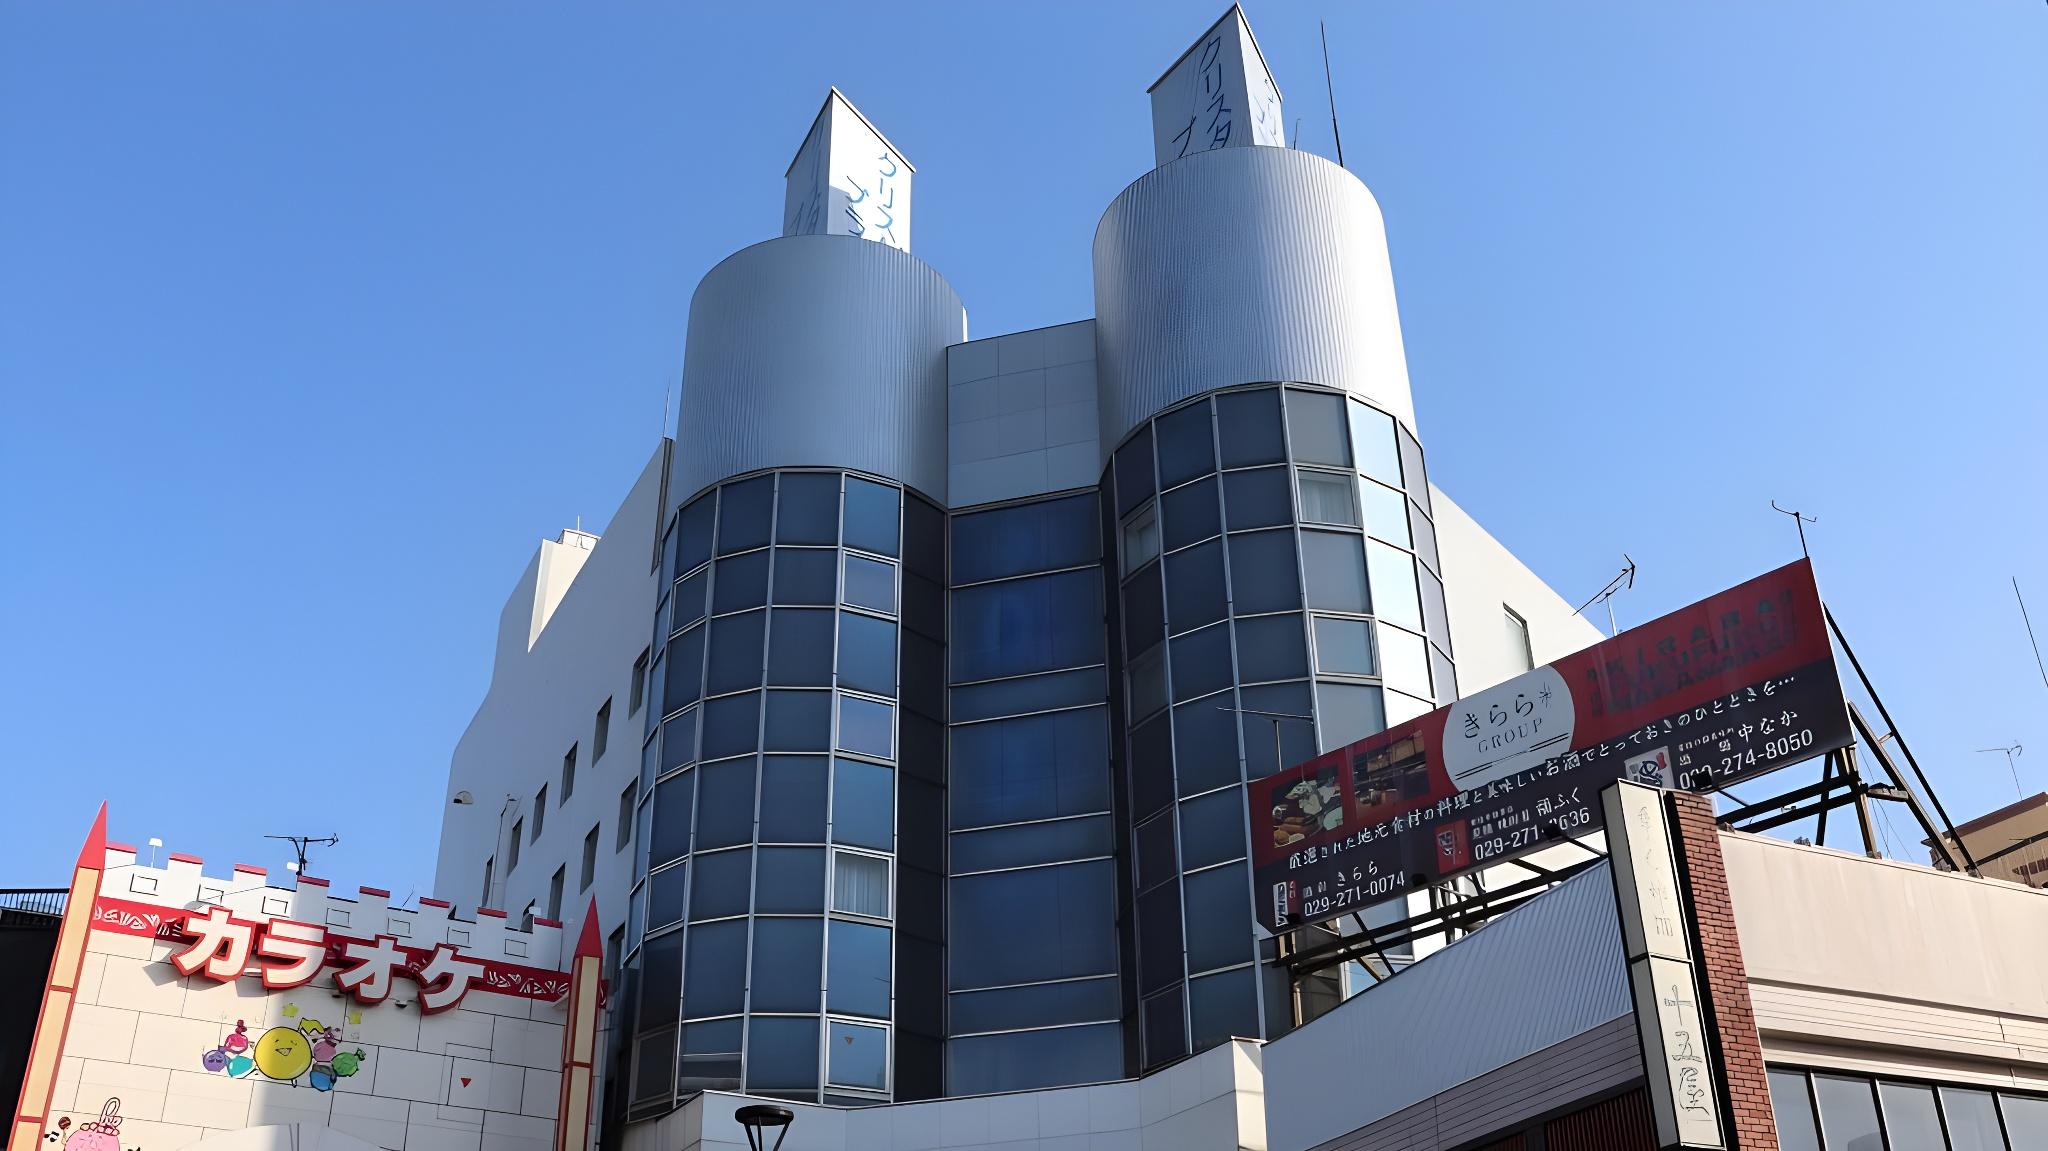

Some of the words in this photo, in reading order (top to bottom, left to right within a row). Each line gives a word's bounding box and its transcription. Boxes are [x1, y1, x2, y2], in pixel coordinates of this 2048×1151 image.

[1464, 693, 1534, 739] きらら
[1478, 717, 1543, 753] GROUP
[1303, 870, 1406, 917] 029-271-0074
[170, 906, 486, 1015] カラオケ
